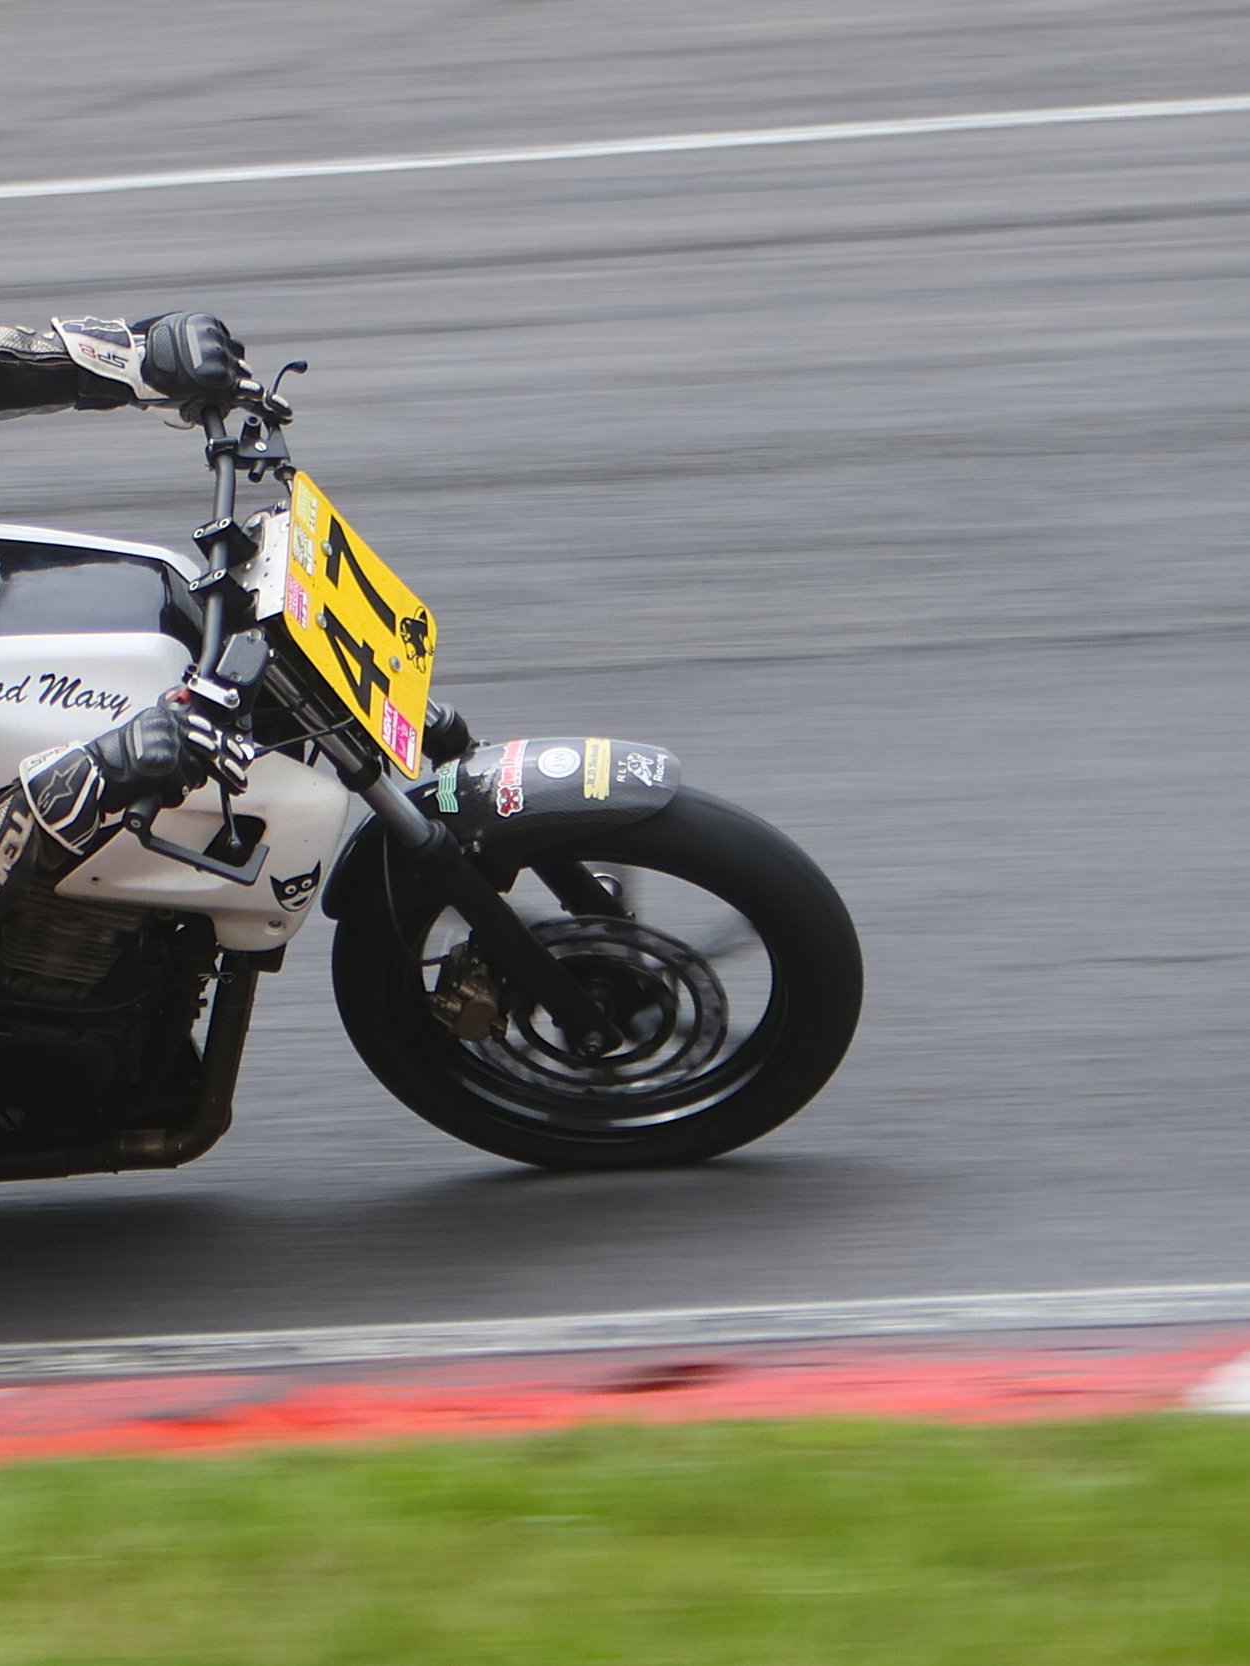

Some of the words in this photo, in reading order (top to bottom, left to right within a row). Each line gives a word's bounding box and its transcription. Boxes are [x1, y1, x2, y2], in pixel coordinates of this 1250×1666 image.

[323, 514, 396, 719] 47
[37, 672, 133, 721] Maxy
[653, 753, 669, 783] Racing
